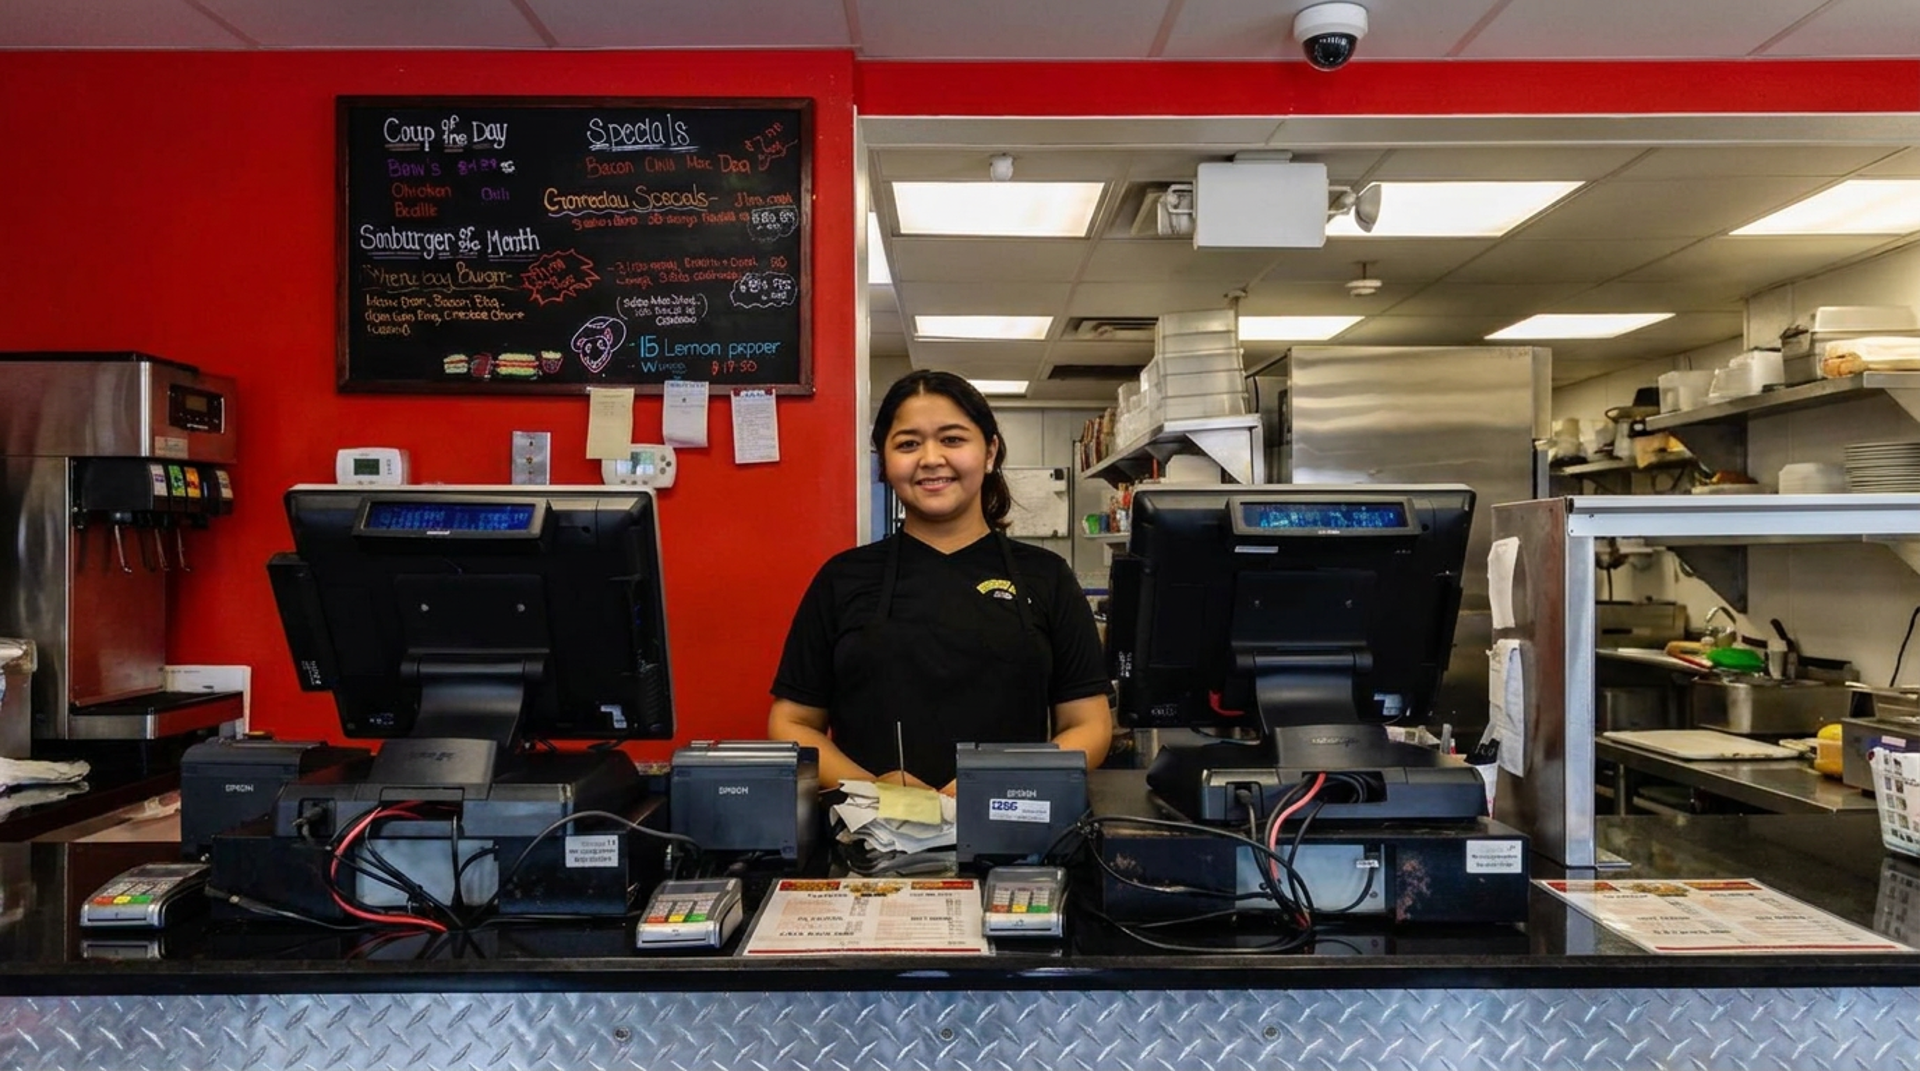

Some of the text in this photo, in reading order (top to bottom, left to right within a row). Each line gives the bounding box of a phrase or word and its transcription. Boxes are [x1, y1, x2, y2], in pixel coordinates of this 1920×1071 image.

[472, 121, 509, 150] Day
[639, 335, 660, 358] 15
[664, 338, 721, 357] Lemon
